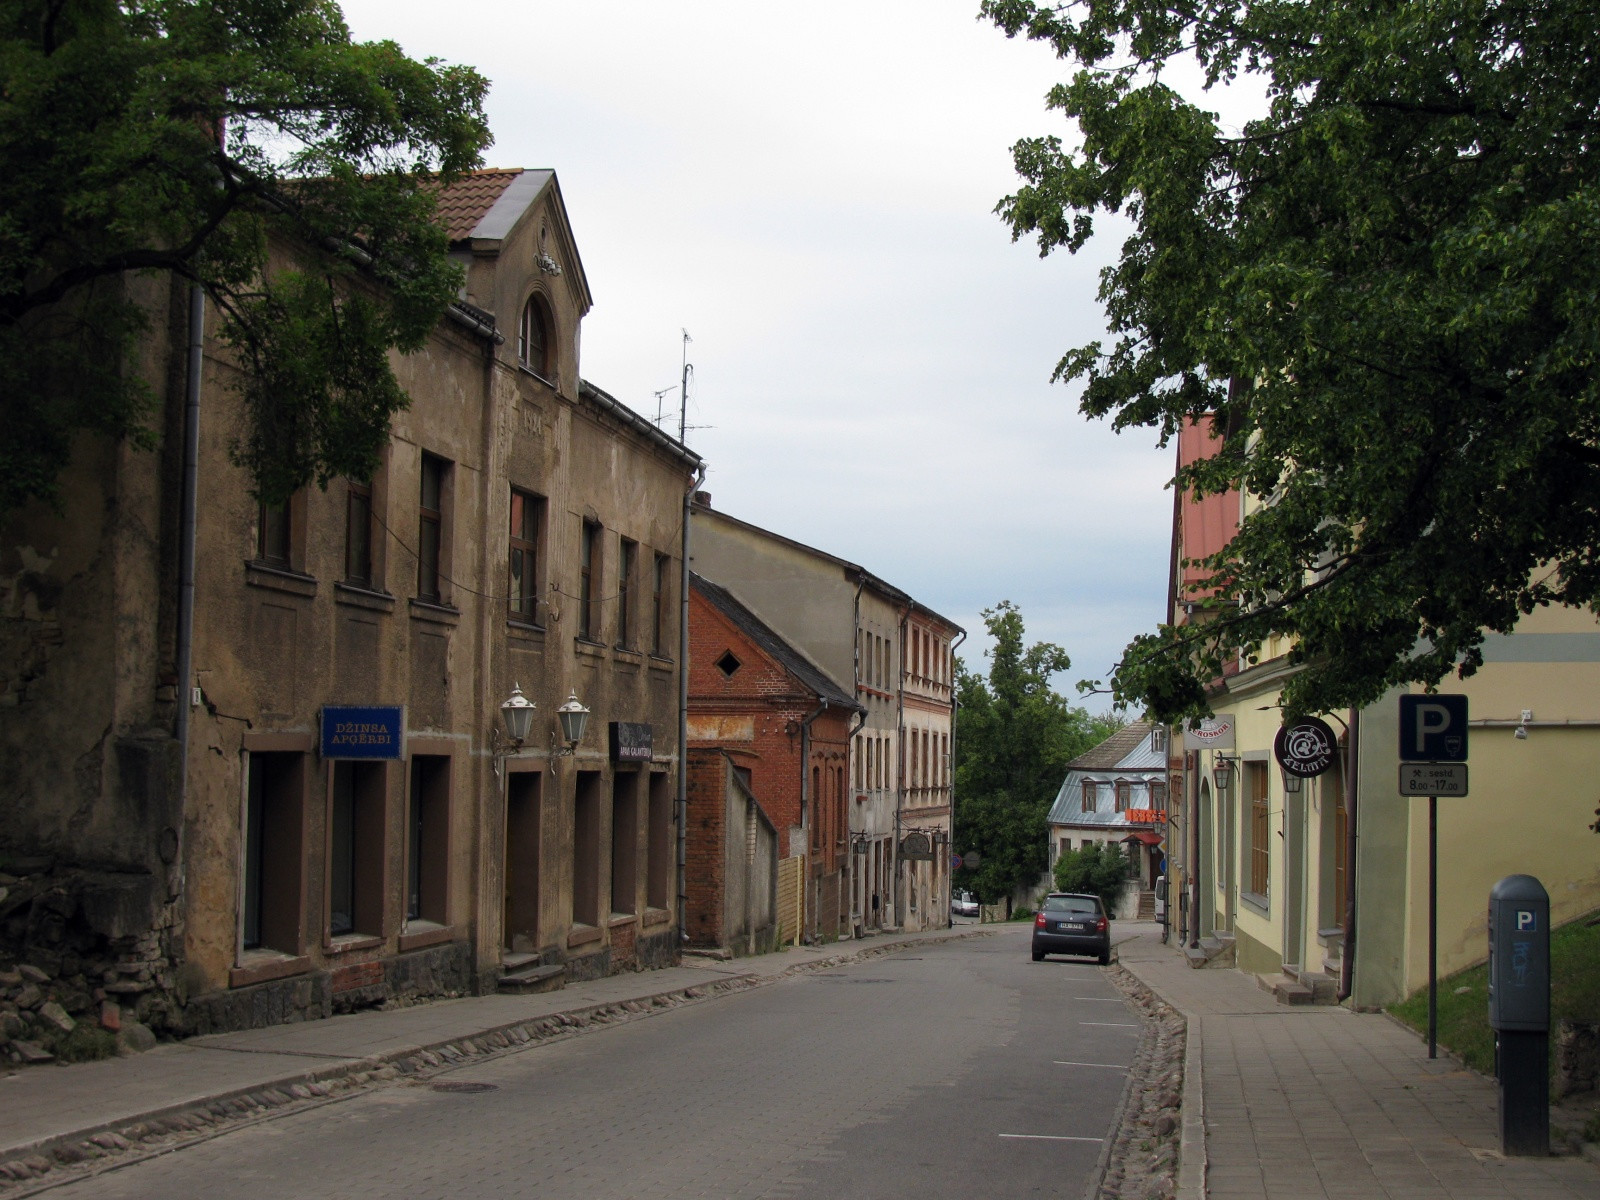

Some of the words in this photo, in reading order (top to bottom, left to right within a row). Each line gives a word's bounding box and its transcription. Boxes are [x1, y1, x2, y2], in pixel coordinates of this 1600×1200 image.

[336, 722, 388, 733] DŽINSA
[1416, 703, 1451, 752] P
[332, 734, 391, 746] APĢĒRBI
[1517, 911, 1533, 930] P
